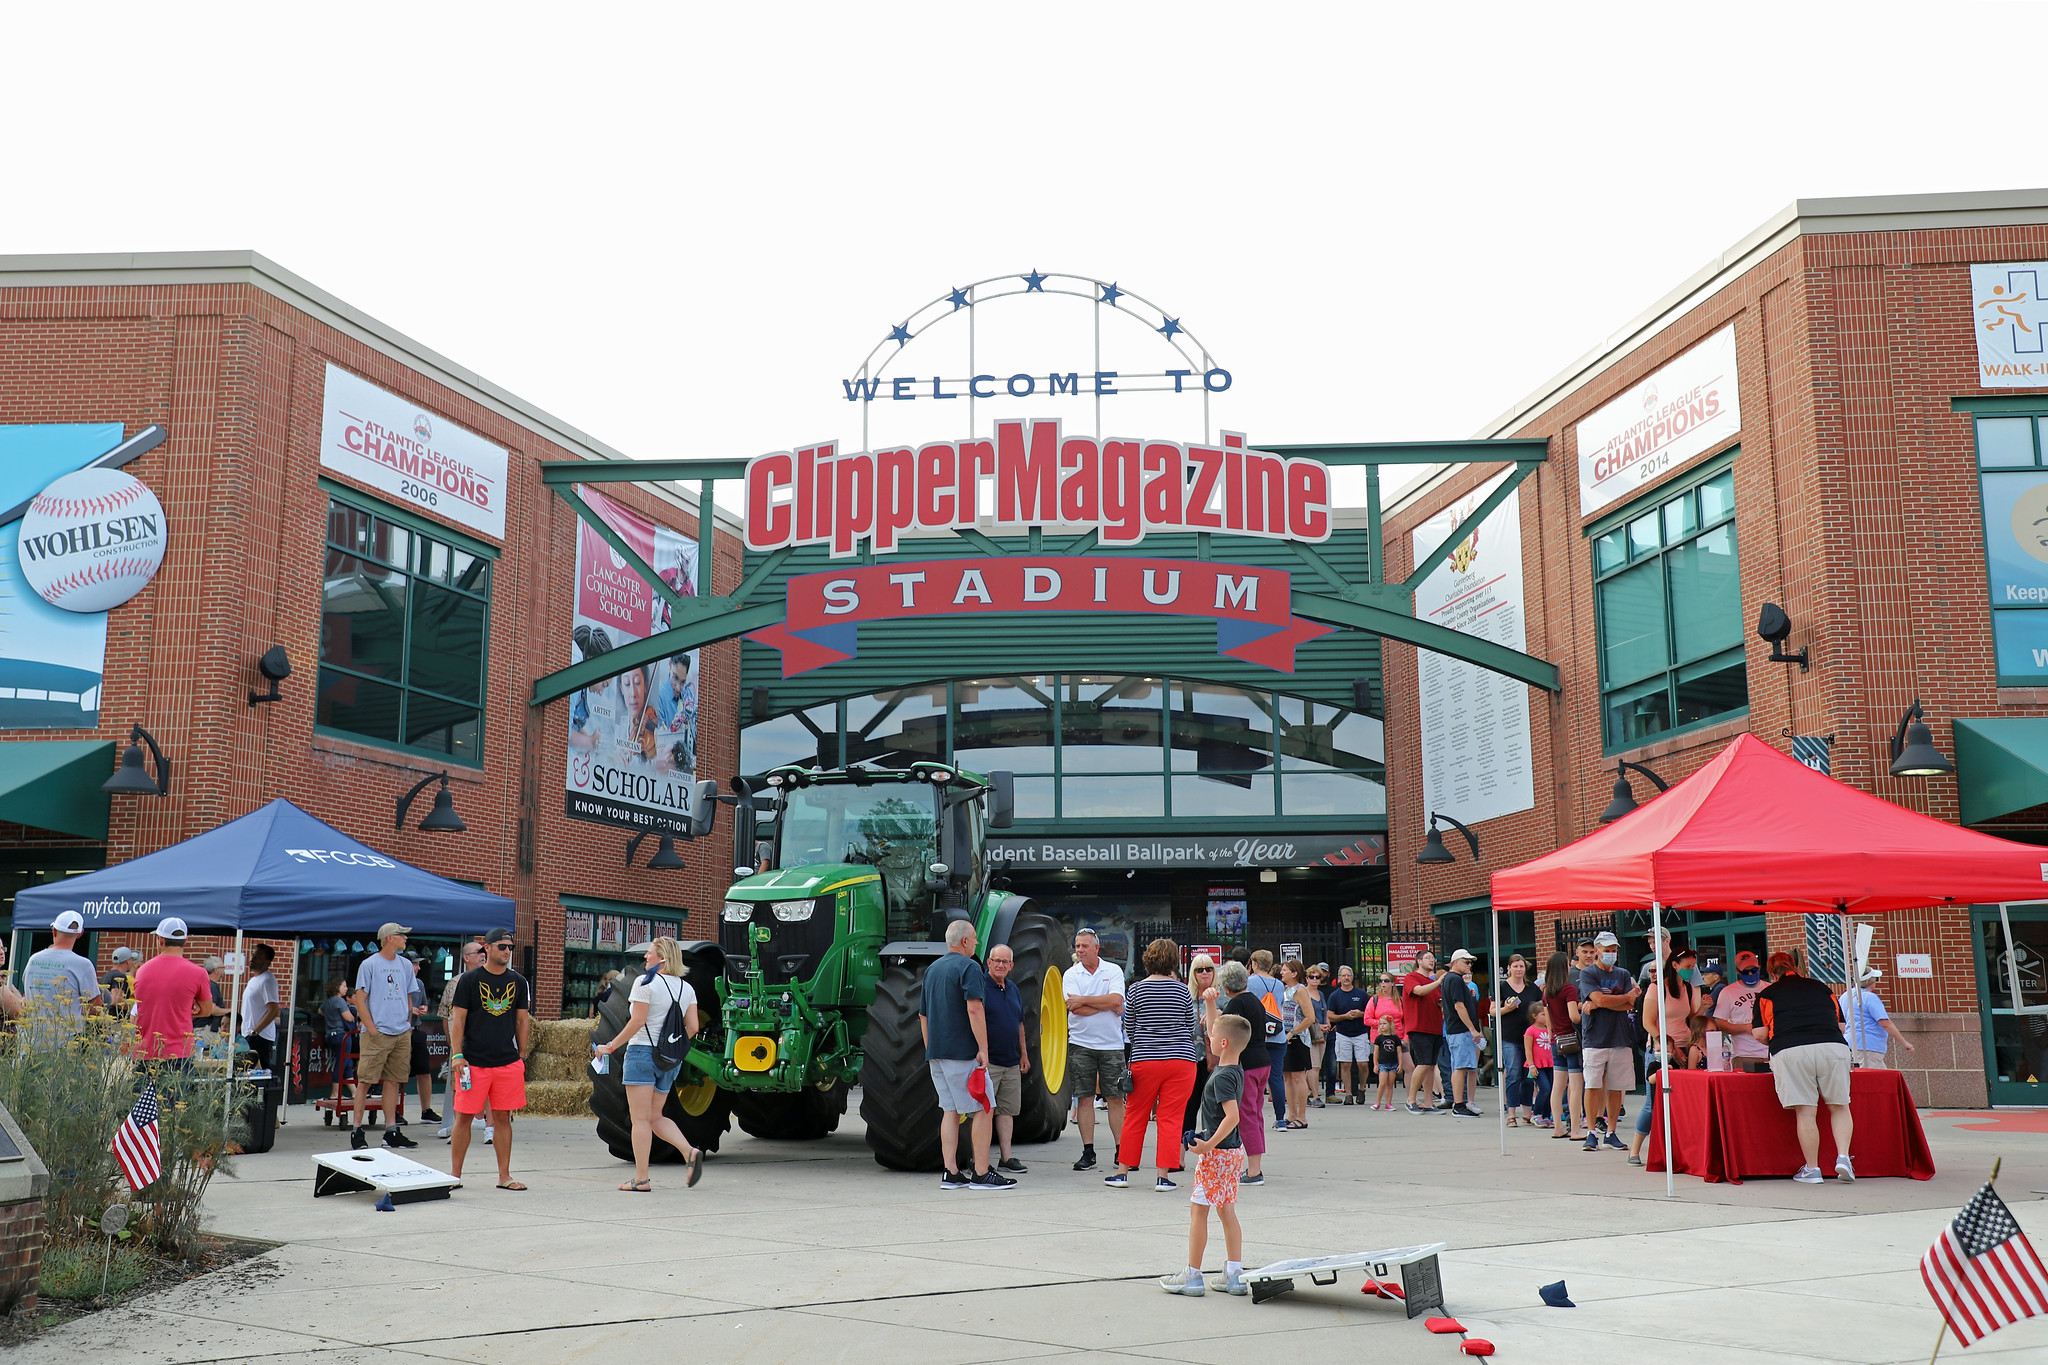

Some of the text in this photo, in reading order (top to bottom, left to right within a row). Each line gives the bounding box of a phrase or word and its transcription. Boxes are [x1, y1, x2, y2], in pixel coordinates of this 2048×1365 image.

[843, 367, 1232, 401] WELCOME TO
[1607, 415, 1653, 452] ATLANTIC
[1656, 386, 1701, 422] LEAGUE
[1594, 390, 1719, 481] CHAMPIONS
[365, 420, 424, 455] ATLANTIC
[427, 447, 474, 478] LEAGUE
[345, 425, 489, 506] CHAMPIONS
[1640, 452, 1669, 479] 2014
[401, 480, 438, 506] 2006
[23, 514, 158, 561] WOHLSEN
[93, 539, 158, 558] CONSTRUCTION
[593, 561, 641, 595] LANCASTER
[822, 567, 1260, 615] STADIUM
[2006, 585, 2048, 603] Keep
[599, 596, 633, 622] SCHOOL
[593, 706, 611, 717] ARTIST
[616, 739, 640, 750] MUSICIAN
[592, 764, 690, 811] SCHOLAR
[669, 771, 691, 782] ENGINEER
[575, 800, 687, 833] KNOW YOUR BEST OTION
[317, 850, 396, 869] FCCB
[1042, 845, 1121, 862] Baseball
[1127, 843, 1206, 865] Ballpark
[1208, 849, 1220, 860] of
[1219, 847, 1233, 858] the
[1233, 838, 1297, 867] Year
[82, 896, 161, 919] myfccb.com
[1367, 906, 1379, 915] 1-12
[601, 921, 616, 941] BAR
[628, 923, 647, 944] COME
[2007, 979, 2038, 988] ETER
[1265, 1022, 1276, 1033] G
